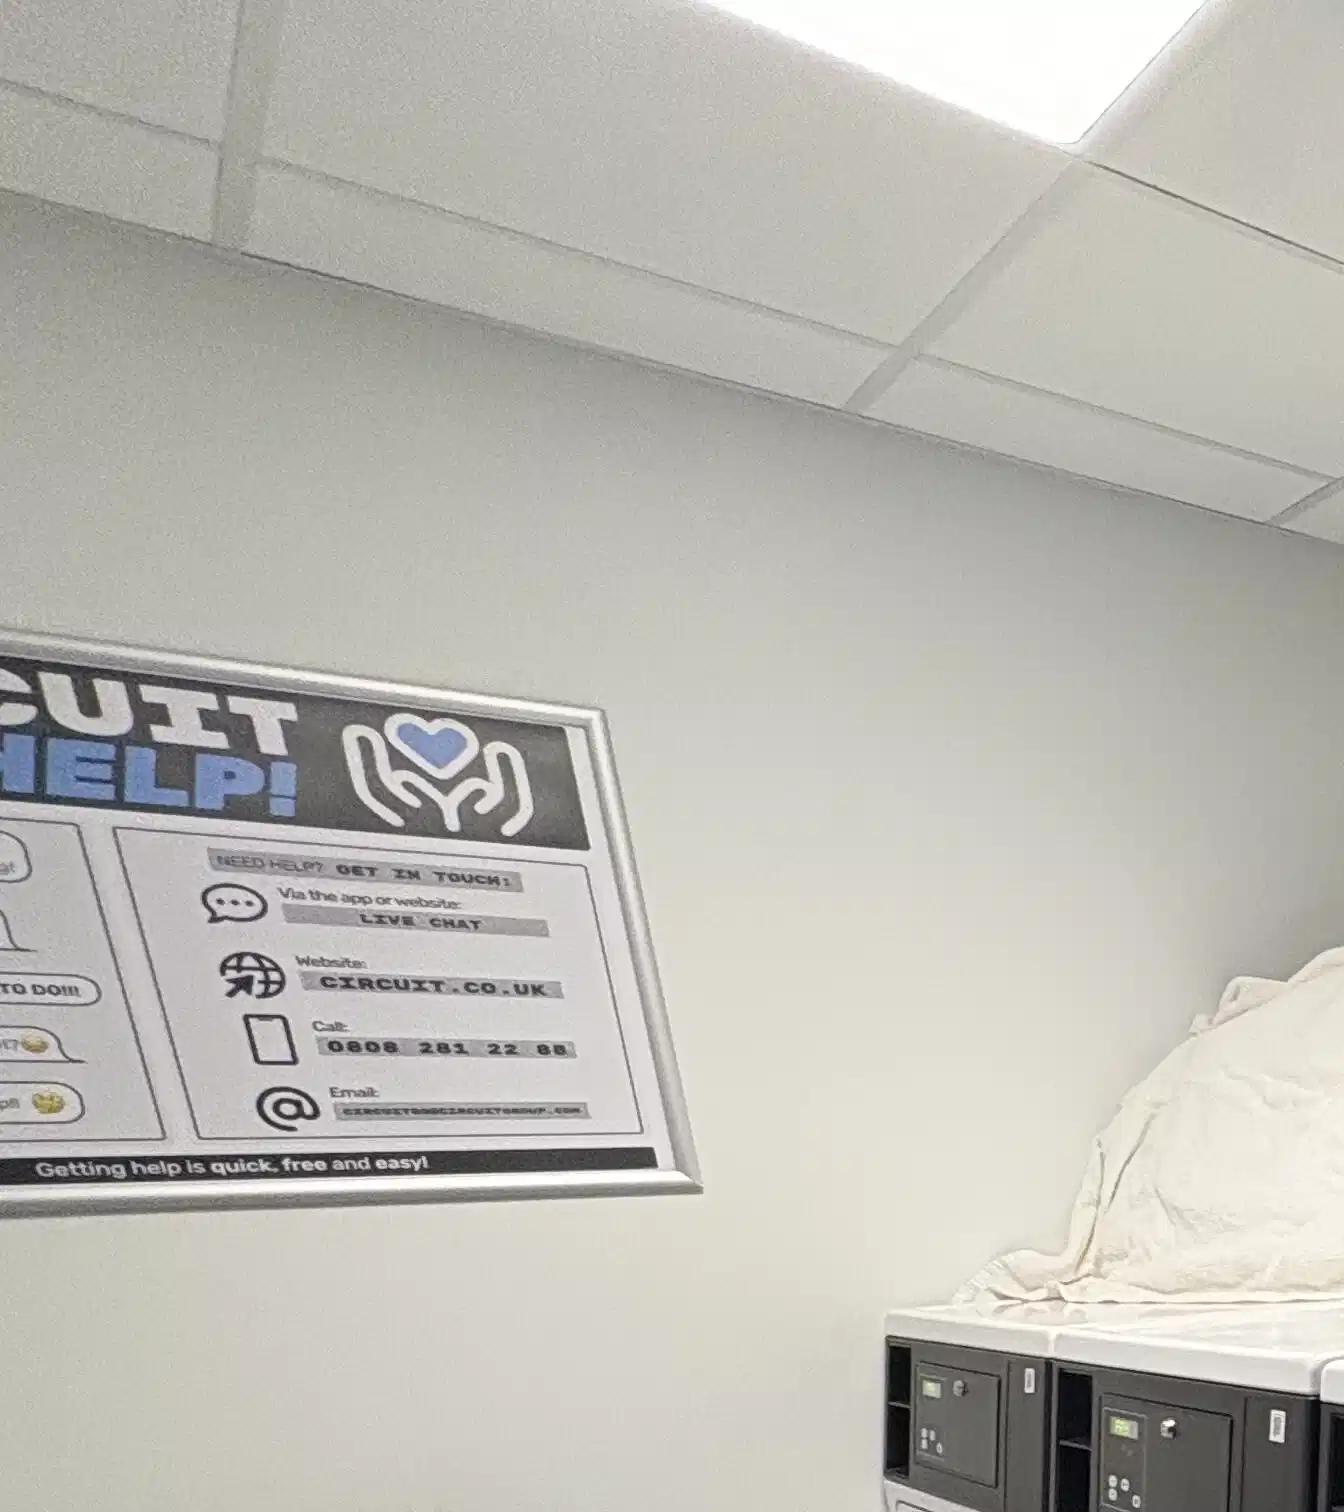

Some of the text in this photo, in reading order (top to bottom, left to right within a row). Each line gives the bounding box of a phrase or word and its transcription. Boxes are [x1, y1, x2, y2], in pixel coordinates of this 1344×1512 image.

[216, 854, 264, 870] NEED
[335, 863, 379, 878] GET
[391, 867, 421, 881] IN
[276, 886, 463, 910] Via the app or website:
[359, 913, 482, 931] LIVE CHAT
[295, 954, 366, 970] Website:
[319, 975, 547, 996] CIRCUIT.CO.UK
[327, 1040, 400, 1054] 0808
[418, 1041, 469, 1055] 281
[486, 1043, 521, 1056] 22
[35, 1155, 430, 1180] Getting help is quick, free and easy!
